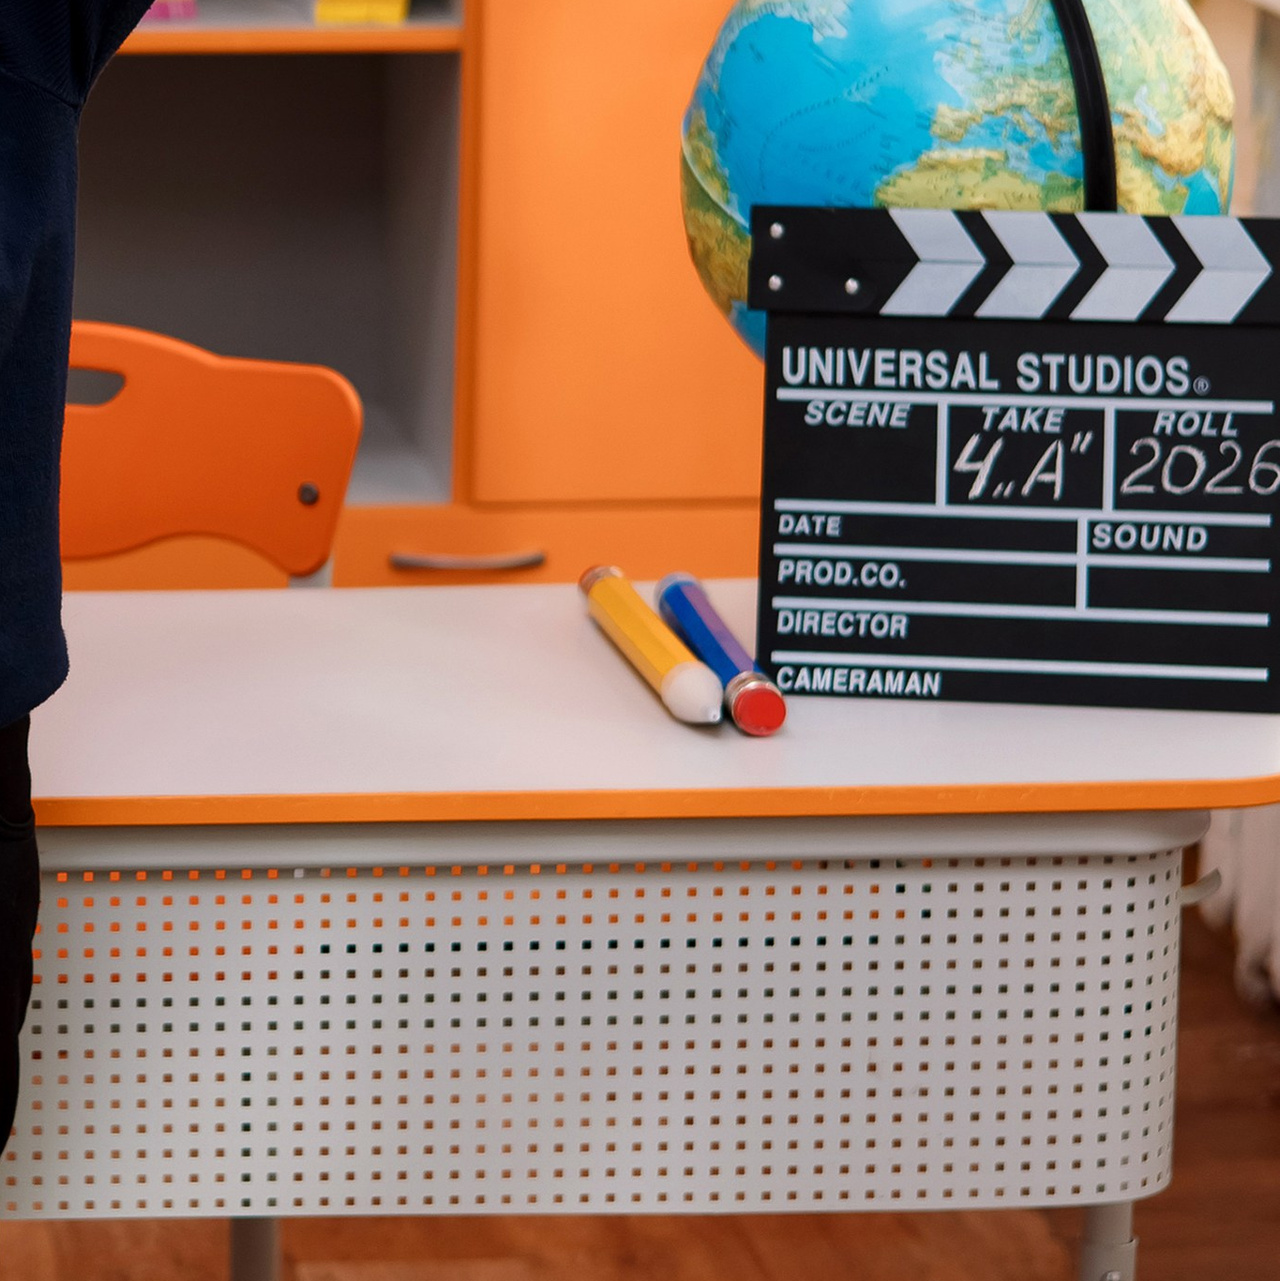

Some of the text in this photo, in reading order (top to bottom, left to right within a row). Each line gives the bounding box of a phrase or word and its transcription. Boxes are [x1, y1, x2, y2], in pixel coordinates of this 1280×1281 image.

[782, 346, 1001, 390] UNIVERSAL
[804, 400, 912, 428] SCENE
[981, 406, 1066, 433] TAKE
[1152, 410, 1239, 437] ROLL
[1120, 436, 1280, 496] 2026
[778, 514, 842, 537] DATE
[1091, 523, 1208, 552] SOUND
[777, 559, 907, 588] PROD.CO.
[776, 610, 909, 640] DIRECTOR
[776, 666, 942, 696] CAMERAMAN
